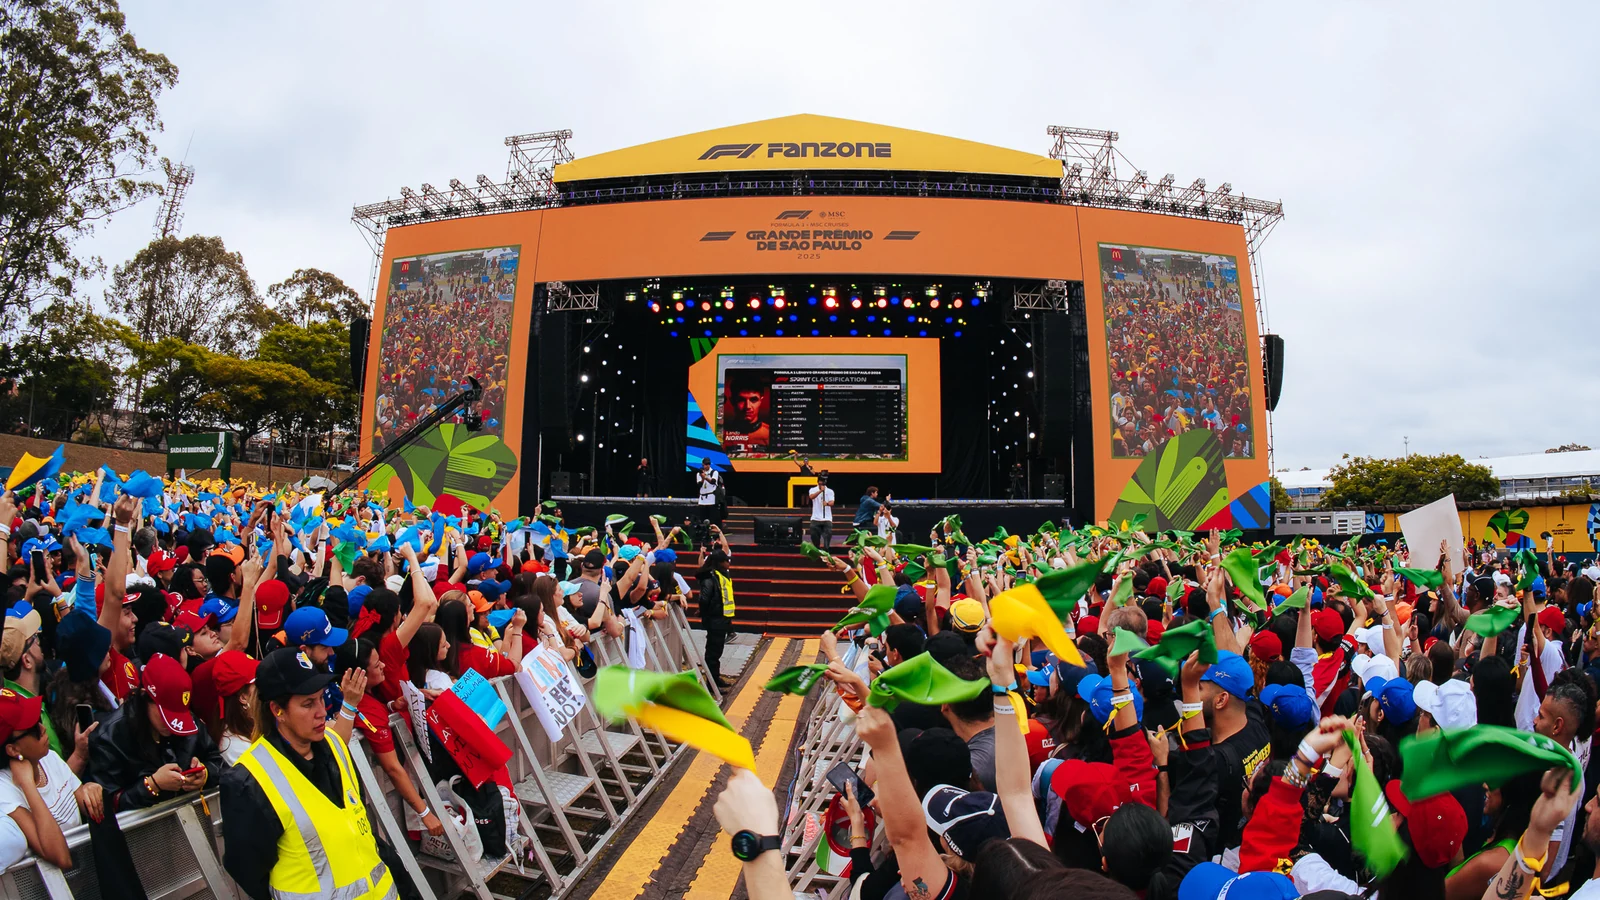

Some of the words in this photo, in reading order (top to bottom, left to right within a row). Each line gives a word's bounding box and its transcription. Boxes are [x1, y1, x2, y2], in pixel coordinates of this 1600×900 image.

[767, 142, 892, 158] FANZONE
[746, 230, 810, 240] GRANDE
[812, 229, 873, 240] PRÊMIO
[757, 241, 777, 251] DE
[779, 239, 810, 250] SÃO
[812, 240, 862, 250] PAULO
[464, 668, 476, 685] ARE
[170, 718, 184, 731] 44
